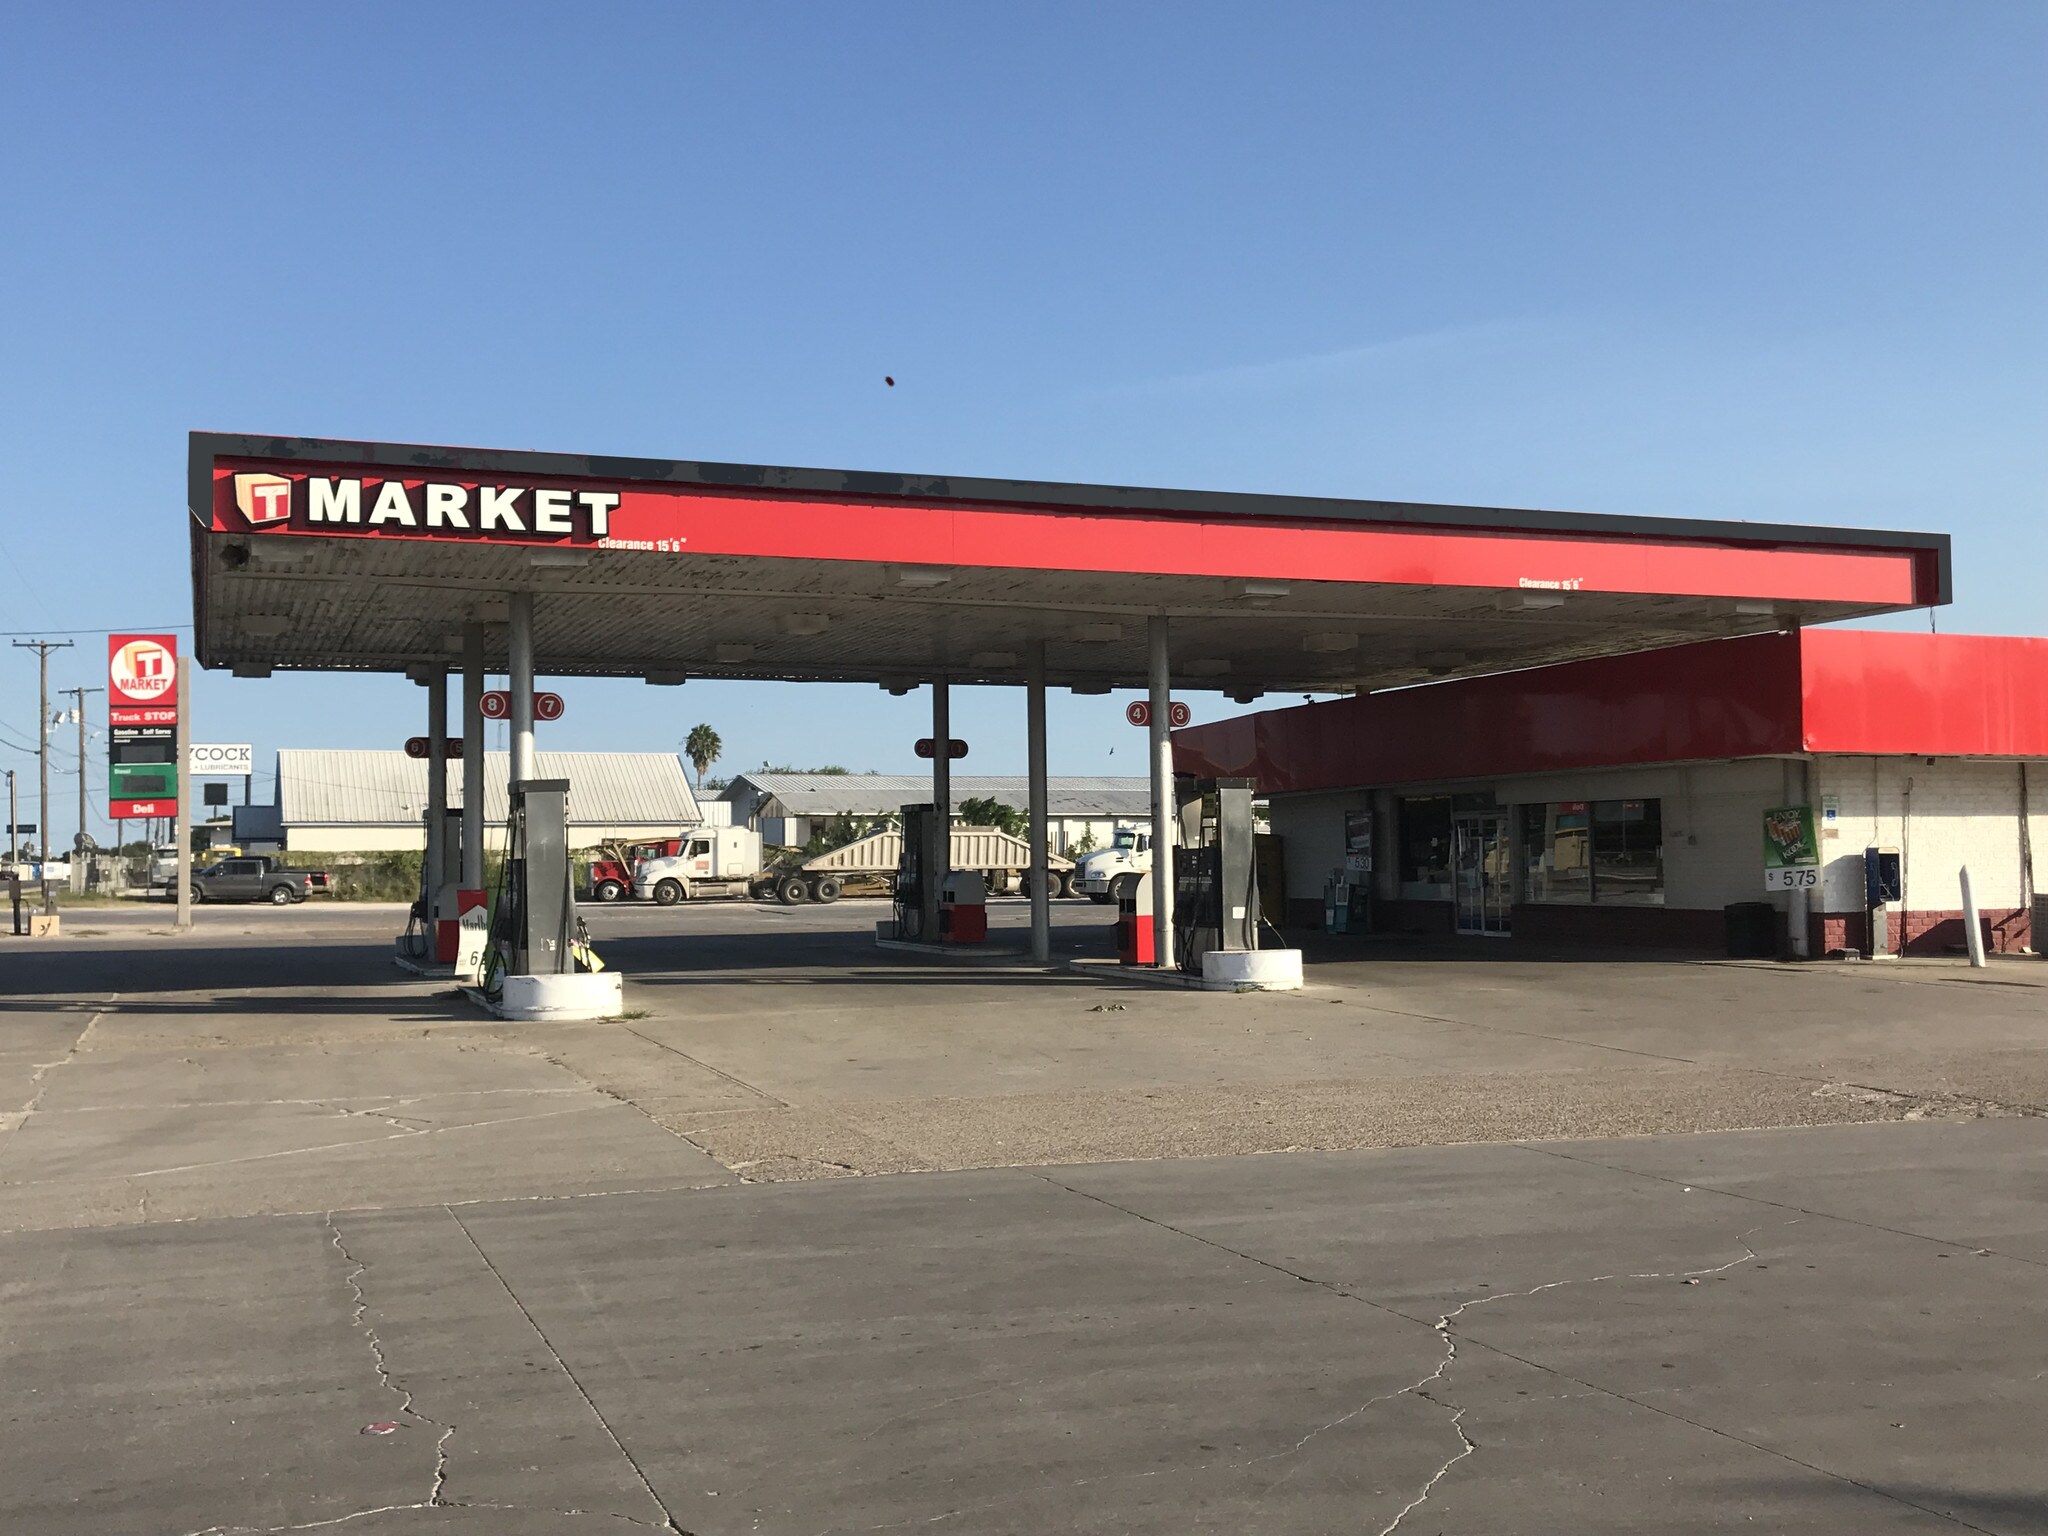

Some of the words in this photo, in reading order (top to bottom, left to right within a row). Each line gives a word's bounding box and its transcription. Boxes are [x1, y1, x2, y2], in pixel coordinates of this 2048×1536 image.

[254, 485, 289, 518] T
[308, 477, 620, 535] MARKET
[598, 537, 654, 550] Clearance
[1519, 577, 1560, 590] Clearance
[136, 651, 162, 677] T
[120, 678, 168, 690] MARKET
[487, 698, 498, 711] 8
[544, 700, 555, 713] 7
[111, 712, 141, 721] Truck
[144, 711, 176, 721] STOP
[1133, 707, 1142, 719] 4
[1176, 708, 1184, 720] 3
[200, 763, 249, 771] LUBRICANTS
[132, 803, 154, 814] Deli
[462, 914, 487, 931] Marlb
